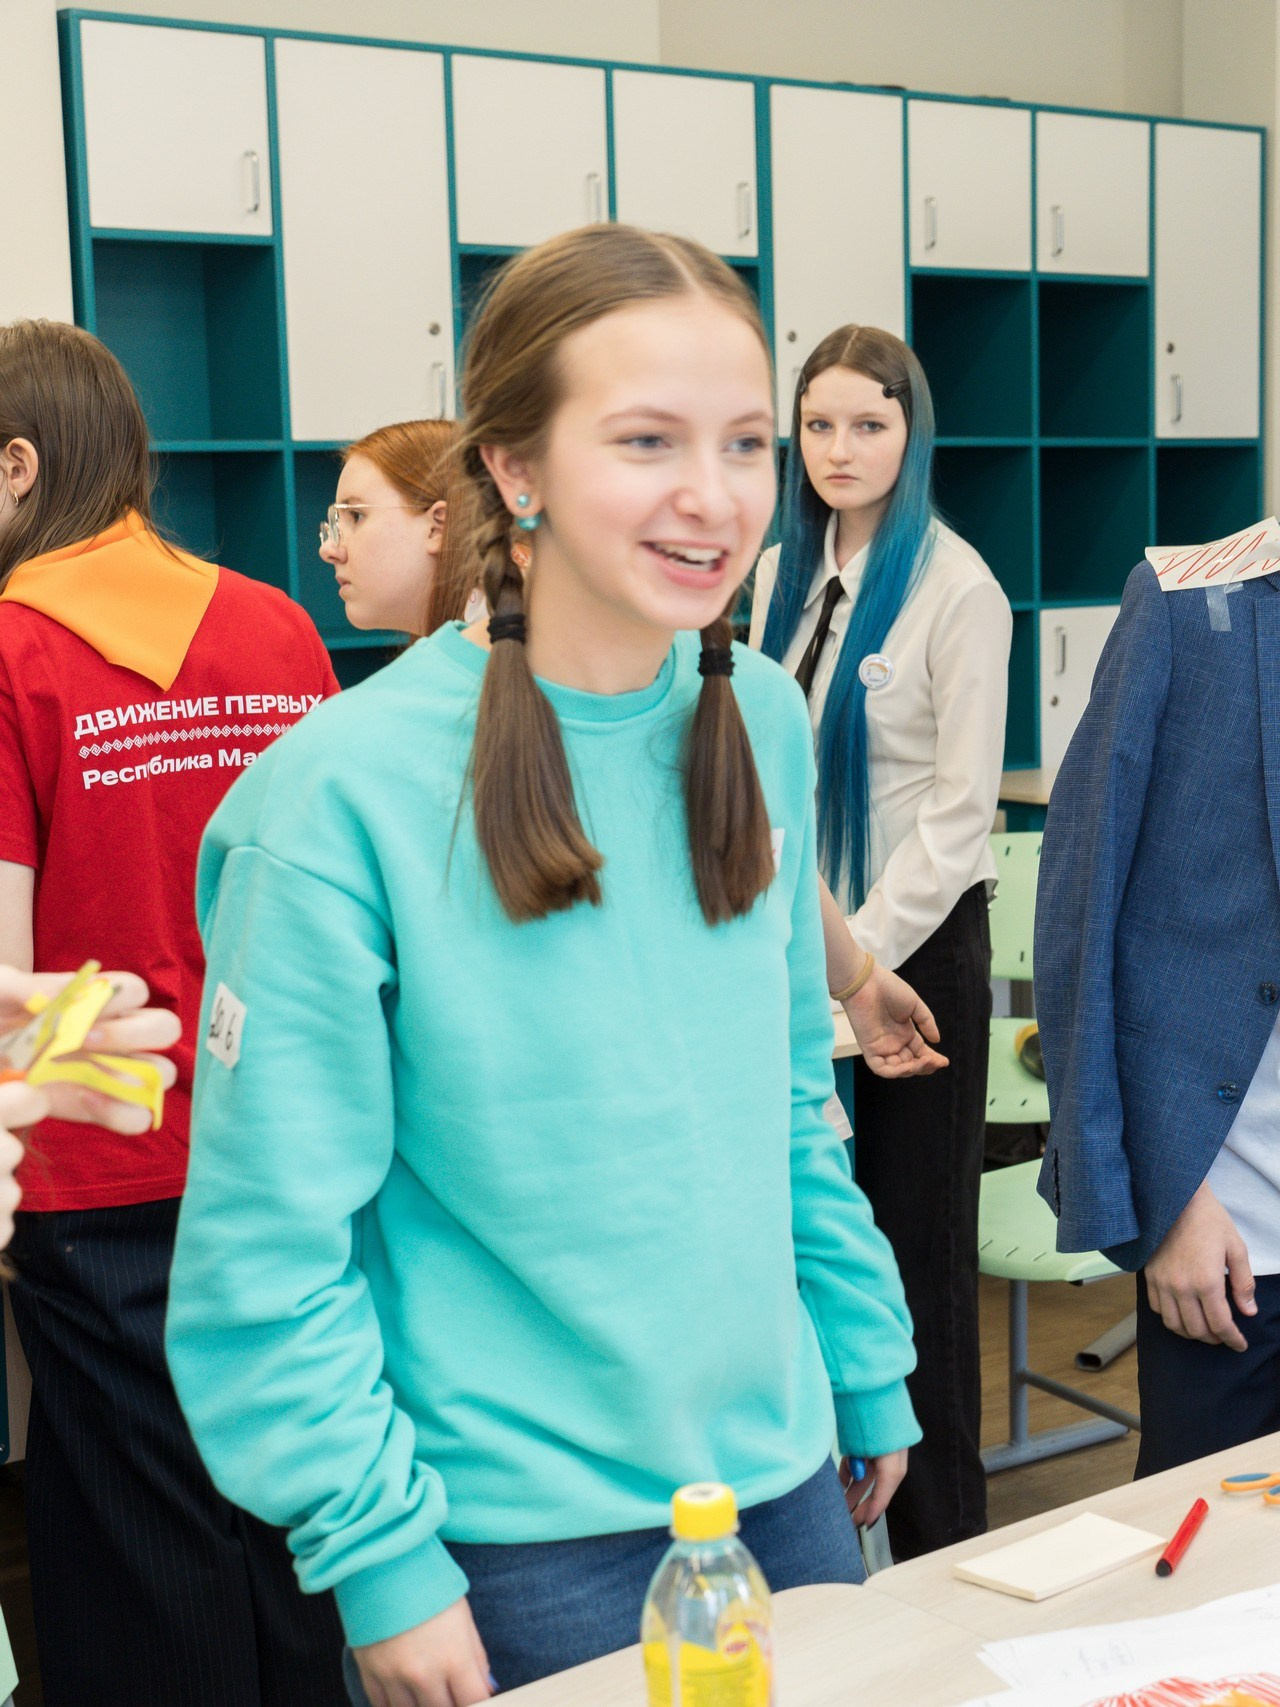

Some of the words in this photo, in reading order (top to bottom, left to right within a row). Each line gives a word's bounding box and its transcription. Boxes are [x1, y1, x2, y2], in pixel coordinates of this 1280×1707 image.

[74, 697, 219, 739] ДВИЖЕНИЕ
[225, 694, 323, 714] ПЕРВЫХ
[82, 753, 213, 790] Респблика
